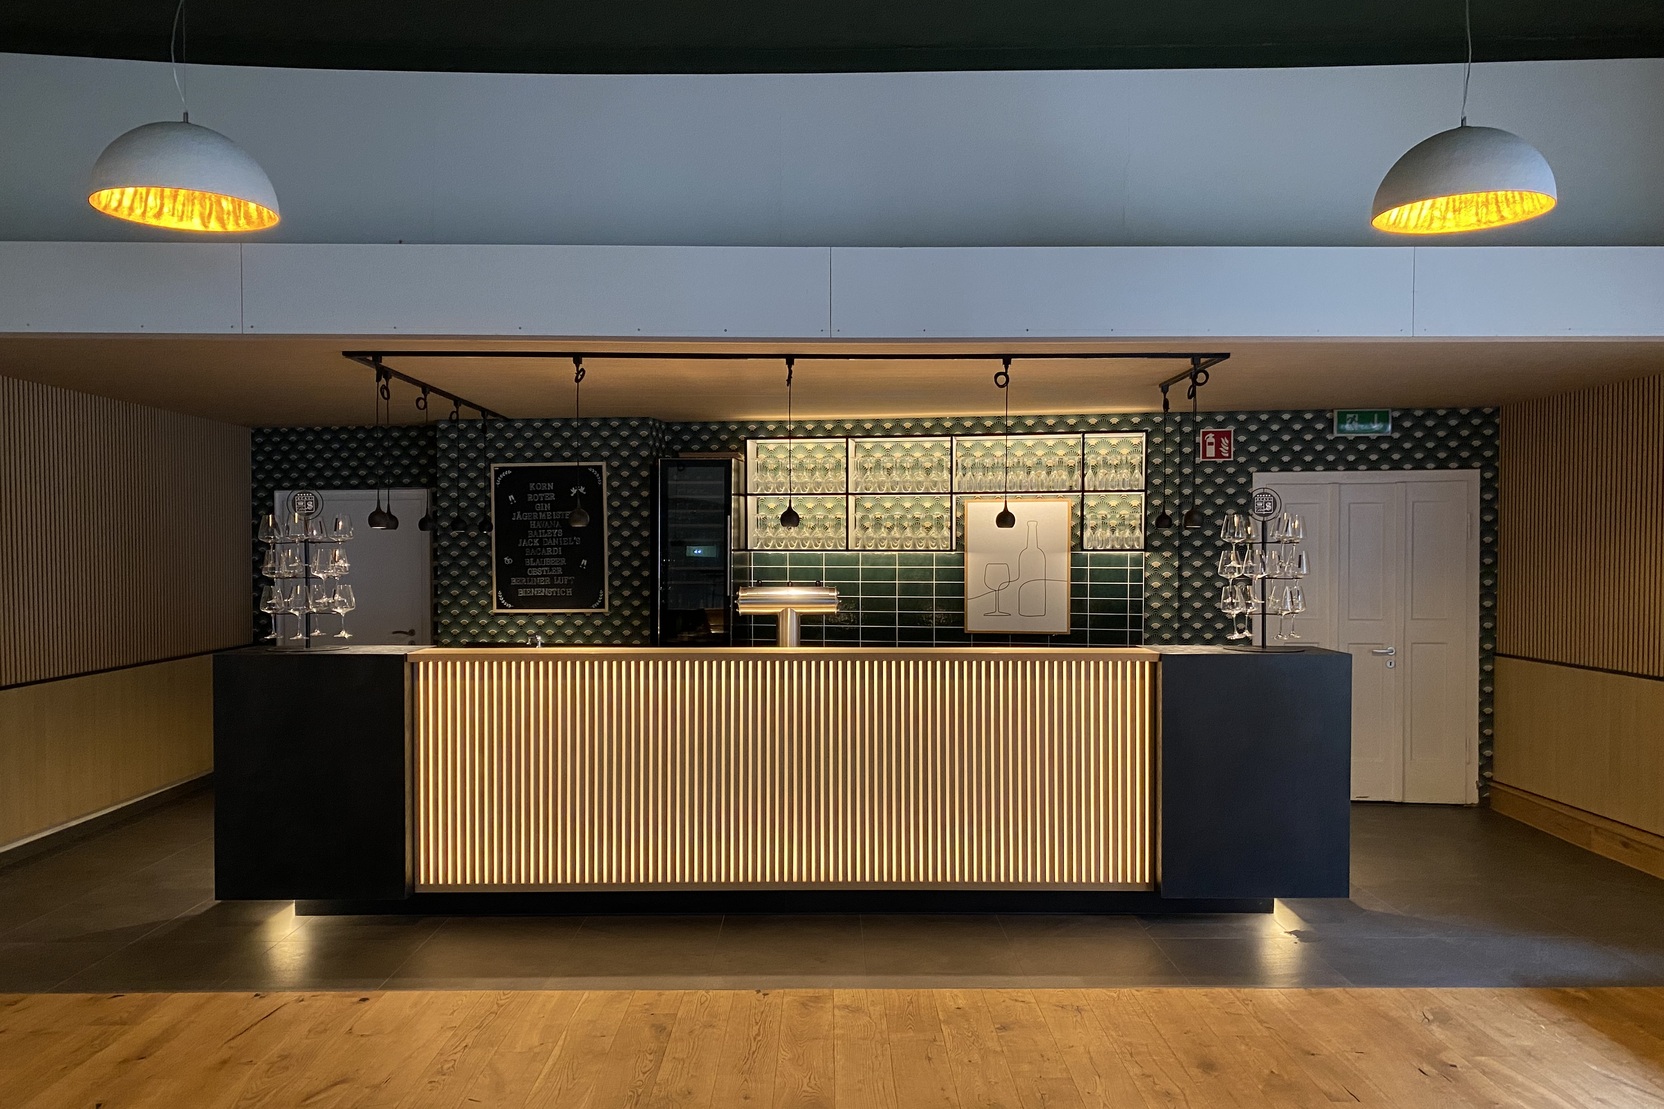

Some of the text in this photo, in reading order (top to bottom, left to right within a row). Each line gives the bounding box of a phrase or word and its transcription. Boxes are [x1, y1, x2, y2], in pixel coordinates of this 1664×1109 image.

[529, 482, 554, 491] KORN
[527, 493, 555, 501] ROTER
[535, 503, 550, 511] GIN
[512, 511, 574, 520] JÄGERMEISTE
[528, 530, 563, 538] BAILEYS
[518, 537, 580, 546] JACK DANIEL'S
[526, 548, 562, 556] BACARDI
[525, 558, 566, 566] BLAUBEER
[527, 567, 563, 575] OBSTLER
[511, 576, 574, 585] BERLINER LUFT
[518, 588, 572, 596] BIENENSTICH
